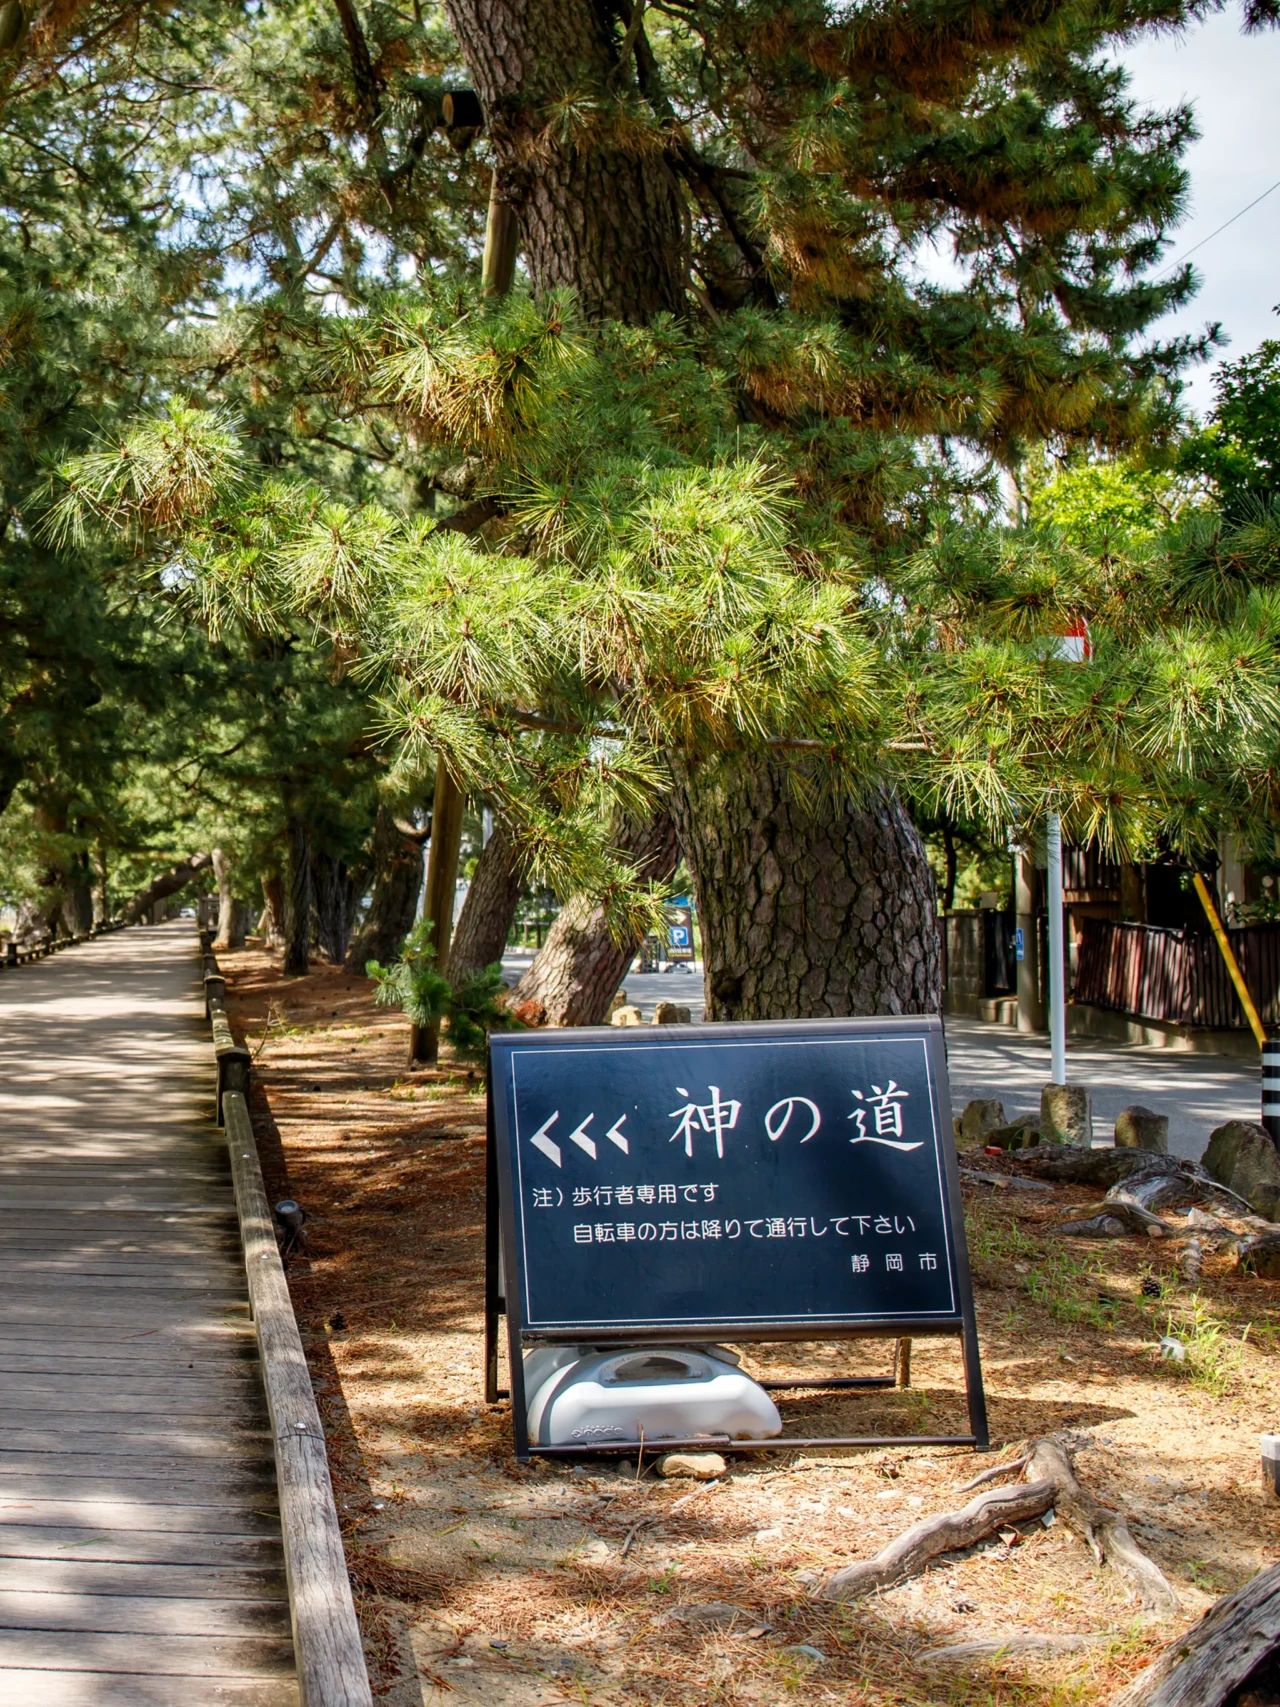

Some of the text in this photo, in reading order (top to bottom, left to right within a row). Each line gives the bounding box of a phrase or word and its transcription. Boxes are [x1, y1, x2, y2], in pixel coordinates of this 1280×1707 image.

[668, 1080, 924, 1158] 神の道
[573, 1215, 916, 1244] 自転車の方は降りて通行して下さい
[851, 1252, 937, 1273] 静岡市
